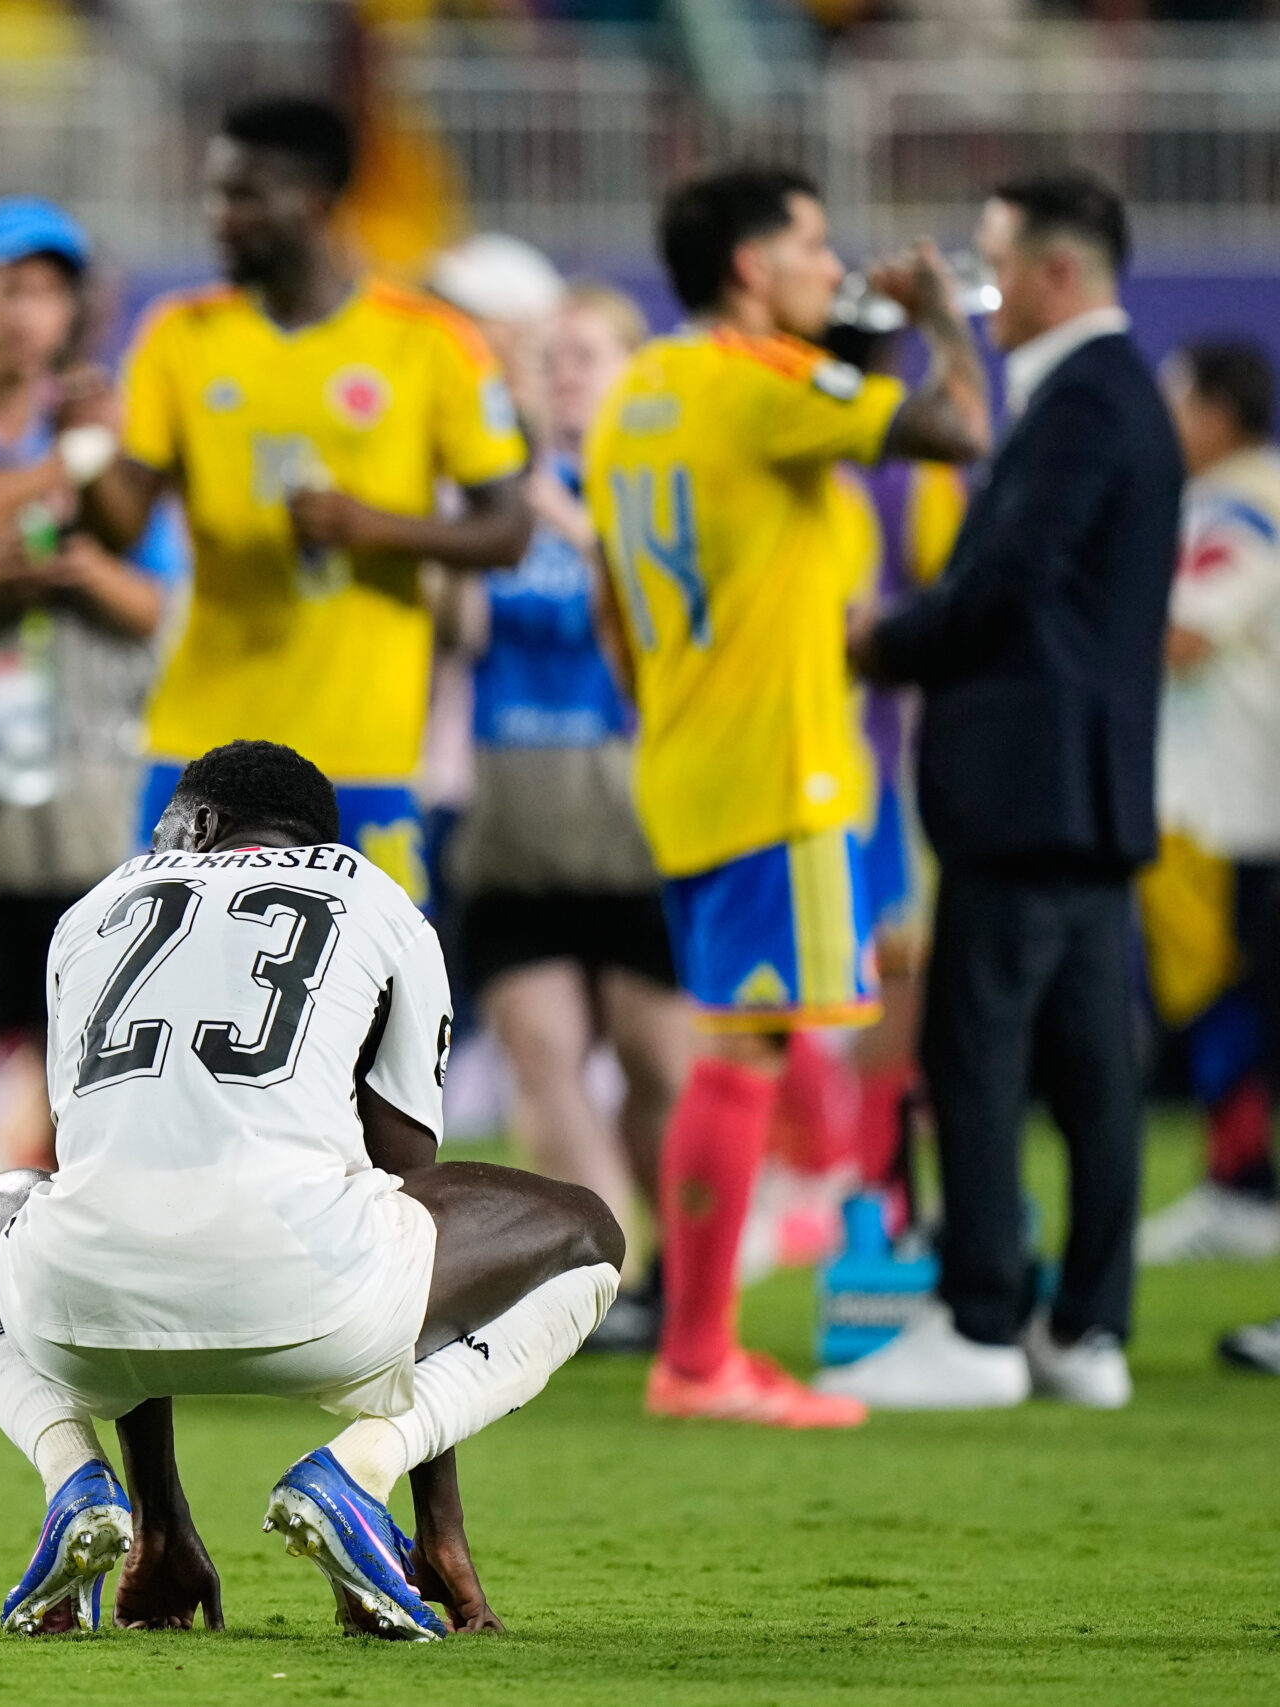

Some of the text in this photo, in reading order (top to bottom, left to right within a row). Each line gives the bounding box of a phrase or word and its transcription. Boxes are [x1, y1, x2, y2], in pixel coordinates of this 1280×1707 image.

[609, 464, 712, 653] 14
[117, 847, 358, 879] LUCKASSEN
[73, 879, 347, 1098] 23
[308, 1484, 354, 1535] AIR ZOOM
